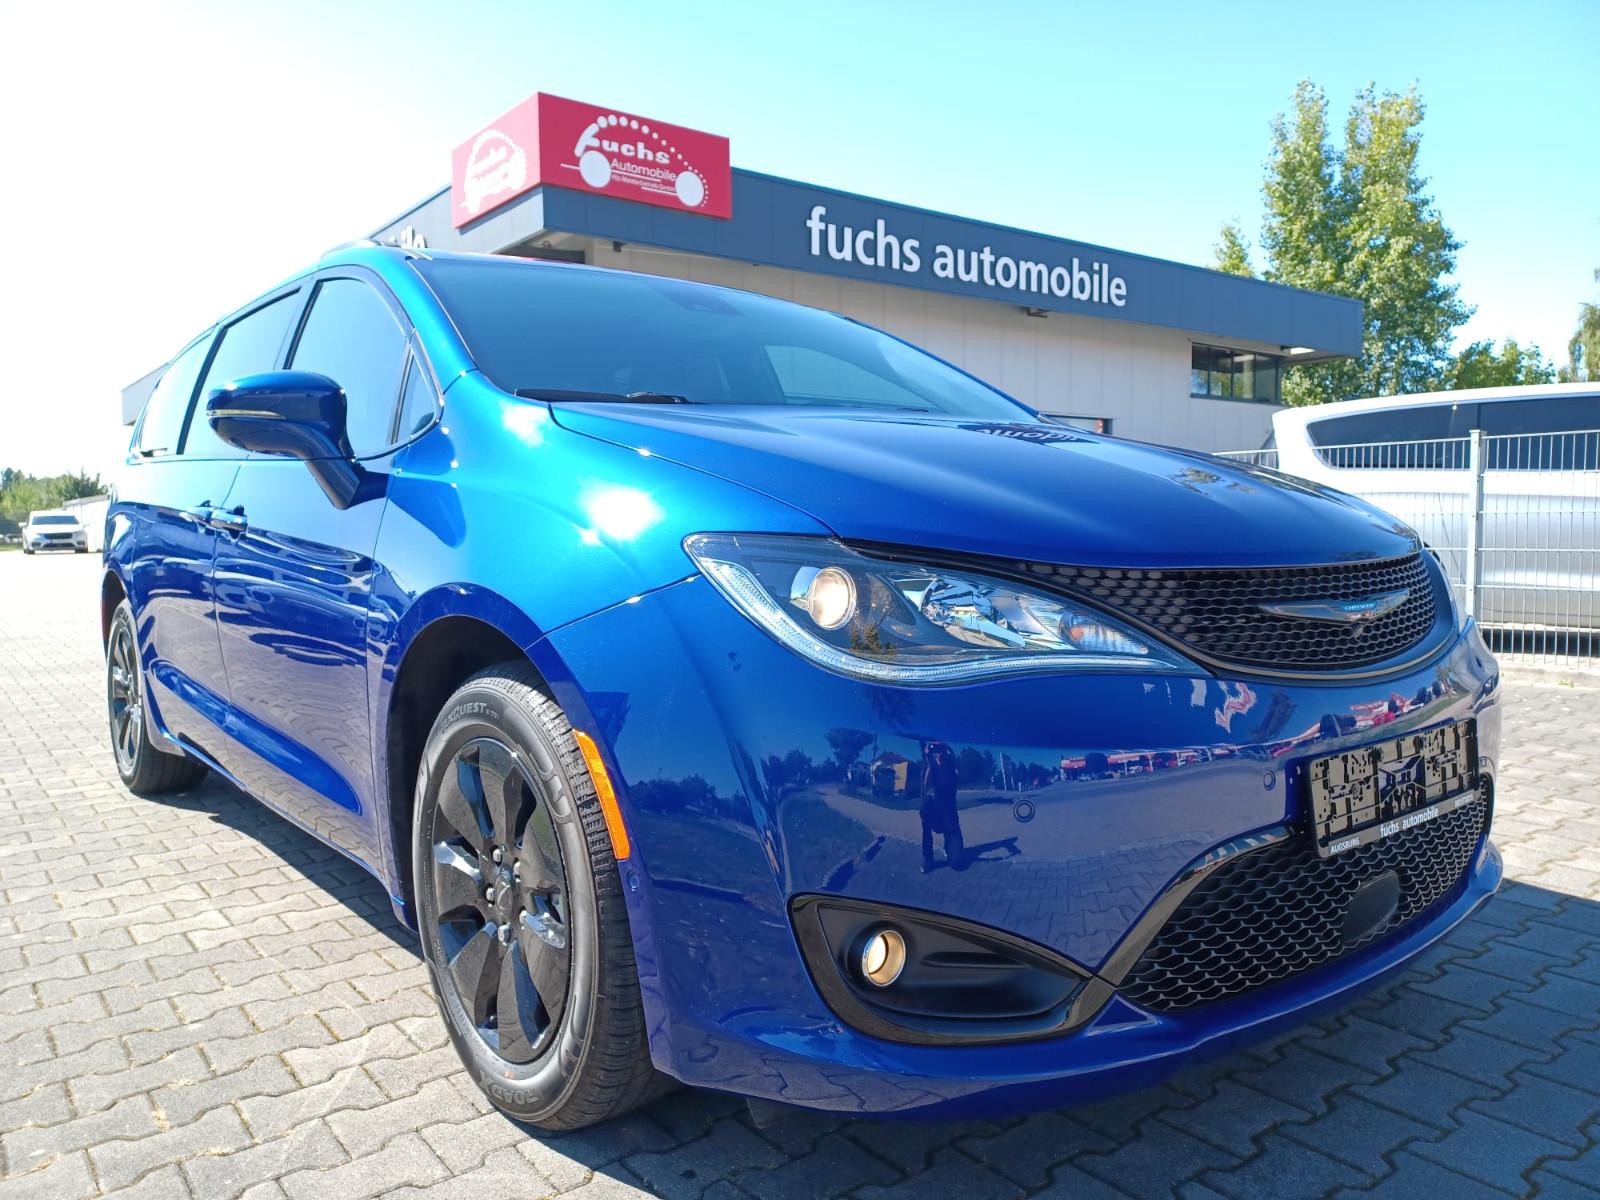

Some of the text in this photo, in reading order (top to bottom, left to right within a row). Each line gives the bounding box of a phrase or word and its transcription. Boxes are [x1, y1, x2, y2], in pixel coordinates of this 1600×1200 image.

[611, 158, 676, 181] Automobile
[806, 205, 1127, 307] fuchs automobile
[1380, 805, 1439, 838] fuchs automobile
[1330, 837, 1360, 855] AUGSBURG
